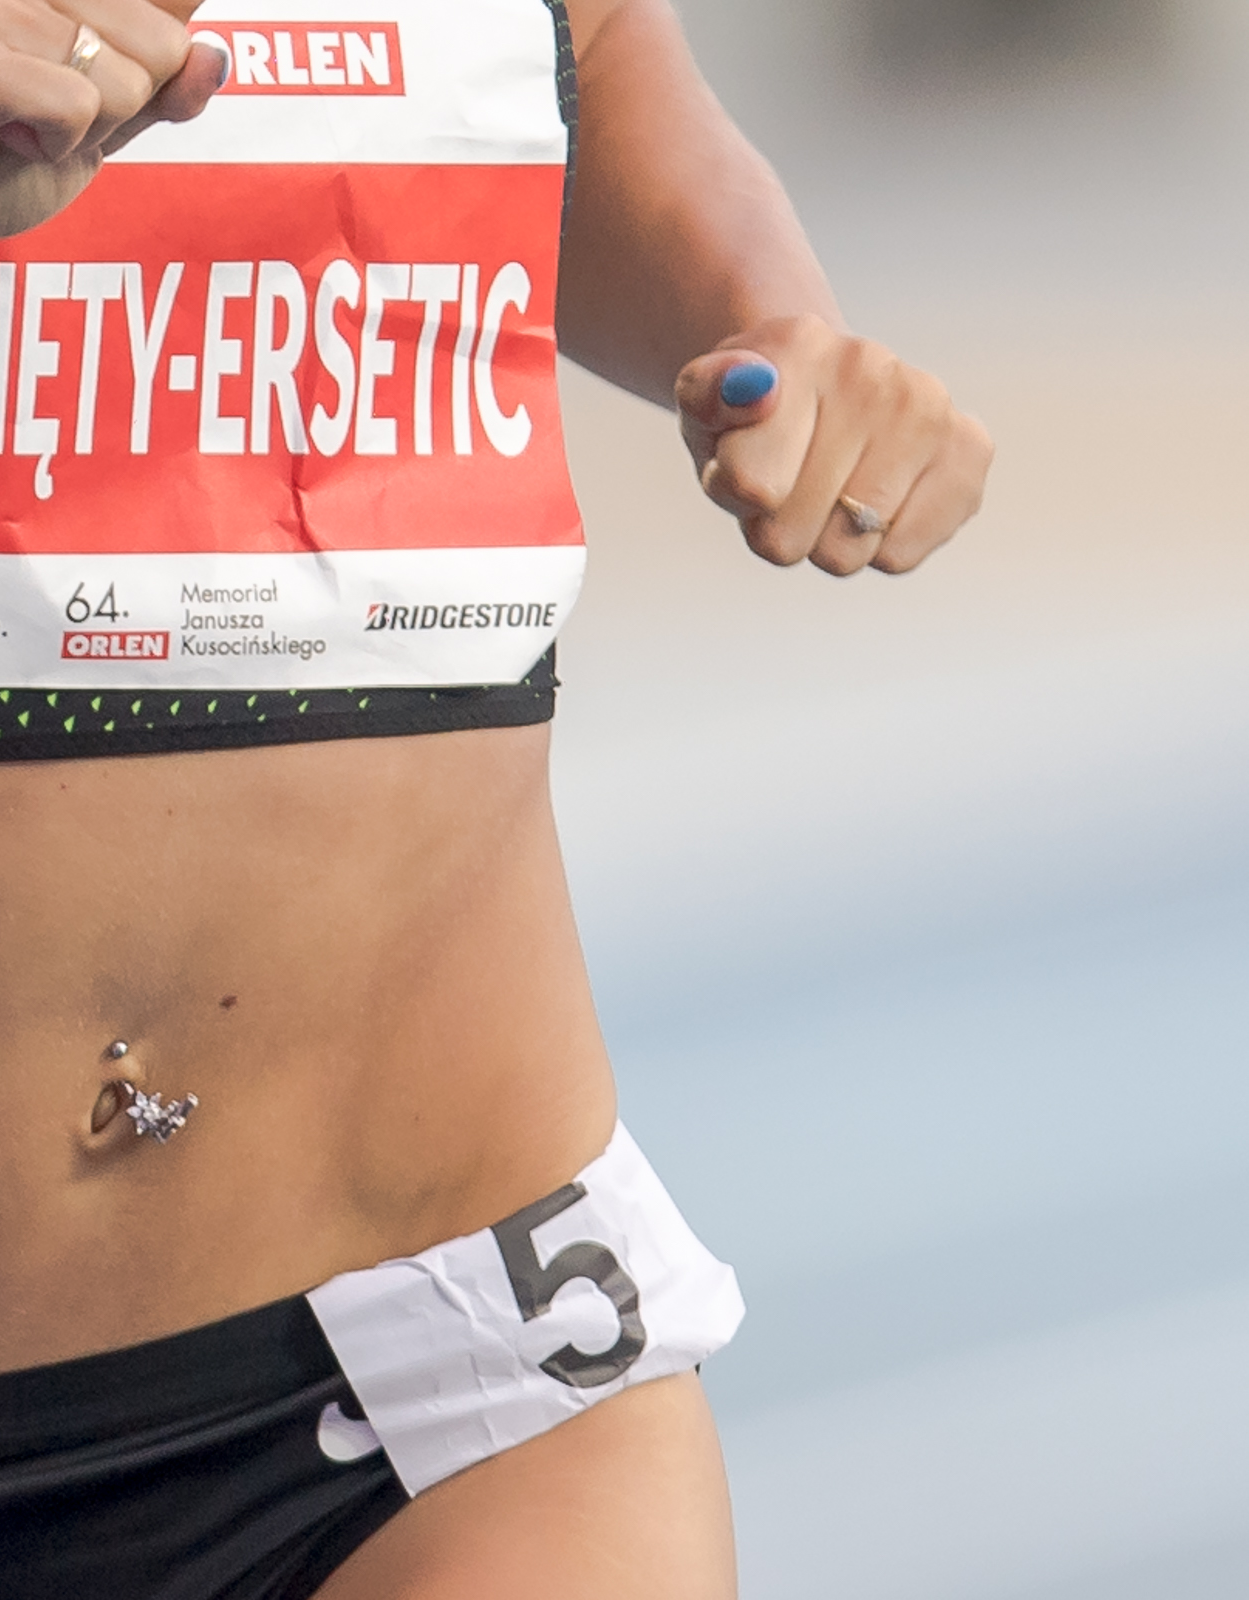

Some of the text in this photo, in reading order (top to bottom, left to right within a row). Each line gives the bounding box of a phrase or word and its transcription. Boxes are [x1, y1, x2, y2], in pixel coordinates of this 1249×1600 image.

[65, 581, 129, 623] 64.
[180, 579, 278, 603] Memoriał
[180, 608, 264, 631] Janusza
[364, 602, 557, 631] BRIDGESTONE
[66, 634, 164, 657] ORLEN
[180, 631, 326, 660] Kusocińskiego
[490, 1179, 647, 1389] 5
